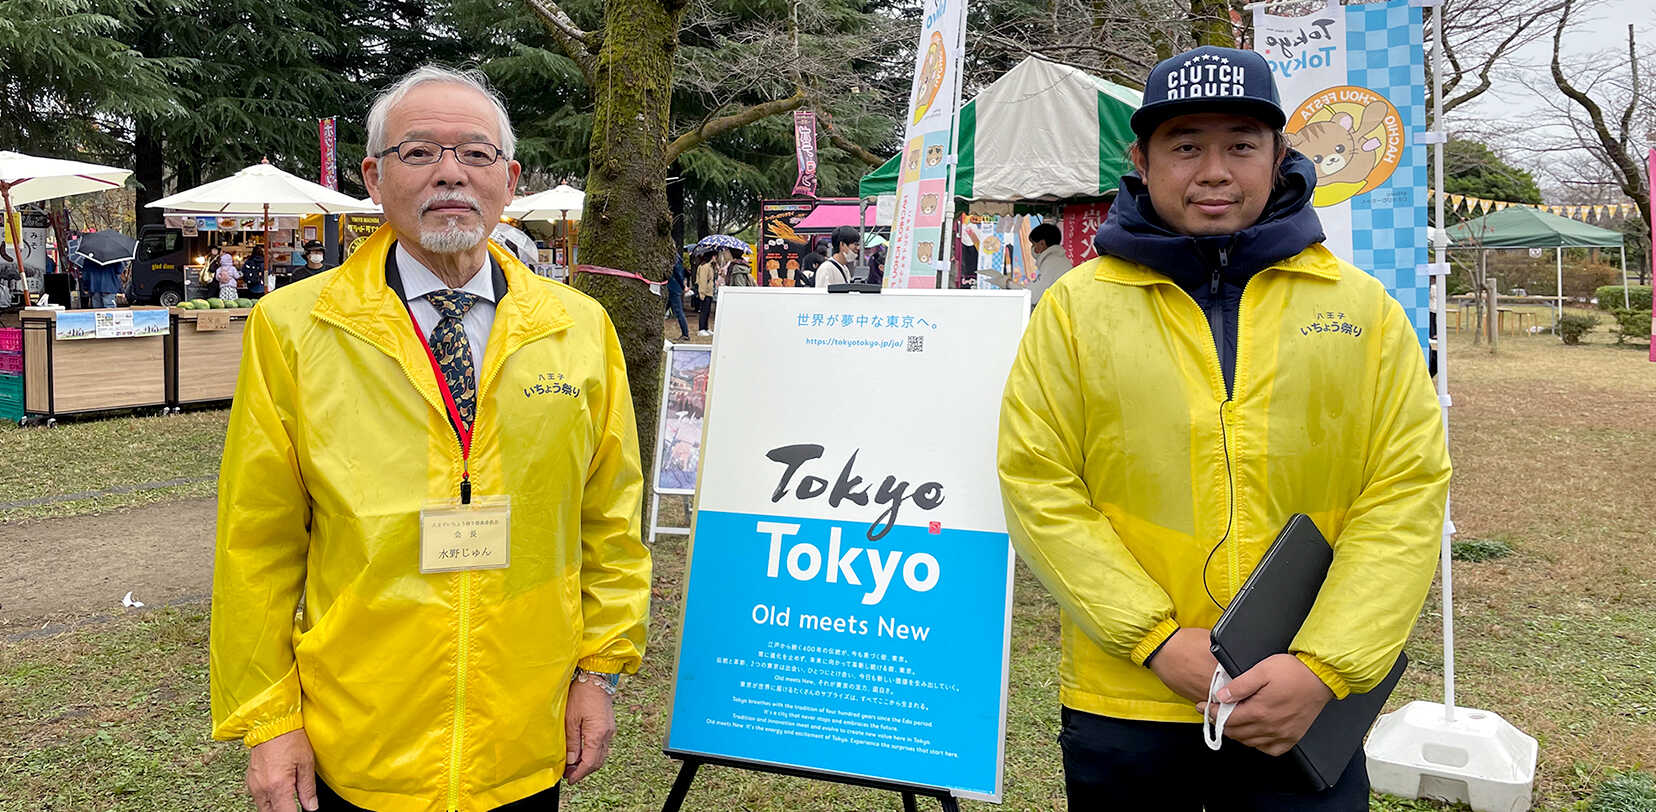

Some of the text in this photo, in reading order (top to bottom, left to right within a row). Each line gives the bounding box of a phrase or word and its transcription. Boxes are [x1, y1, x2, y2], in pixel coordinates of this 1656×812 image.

[1168, 65, 1245, 88] CLUTCH
[797, 313, 937, 329] 世界が夢中な東京へ。
[1317, 311, 1345, 320] 八王子
[1300, 321, 1362, 337] いちょう祭り
[806, 337, 904, 349] https://tokyotokyo.jp/ja/
[538, 372, 564, 381] 八王子
[524, 382, 580, 398] いちょう祭り
[765, 444, 945, 541] Tokyo
[438, 547, 492, 560] 水野じゅん
[756, 521, 940, 605] Tokyo
[752, 604, 930, 641] Old meets New
[732, 696, 746, 704] Tokyo
[837, 709, 860, 717] hundred
[732, 712, 755, 720] Tradition
